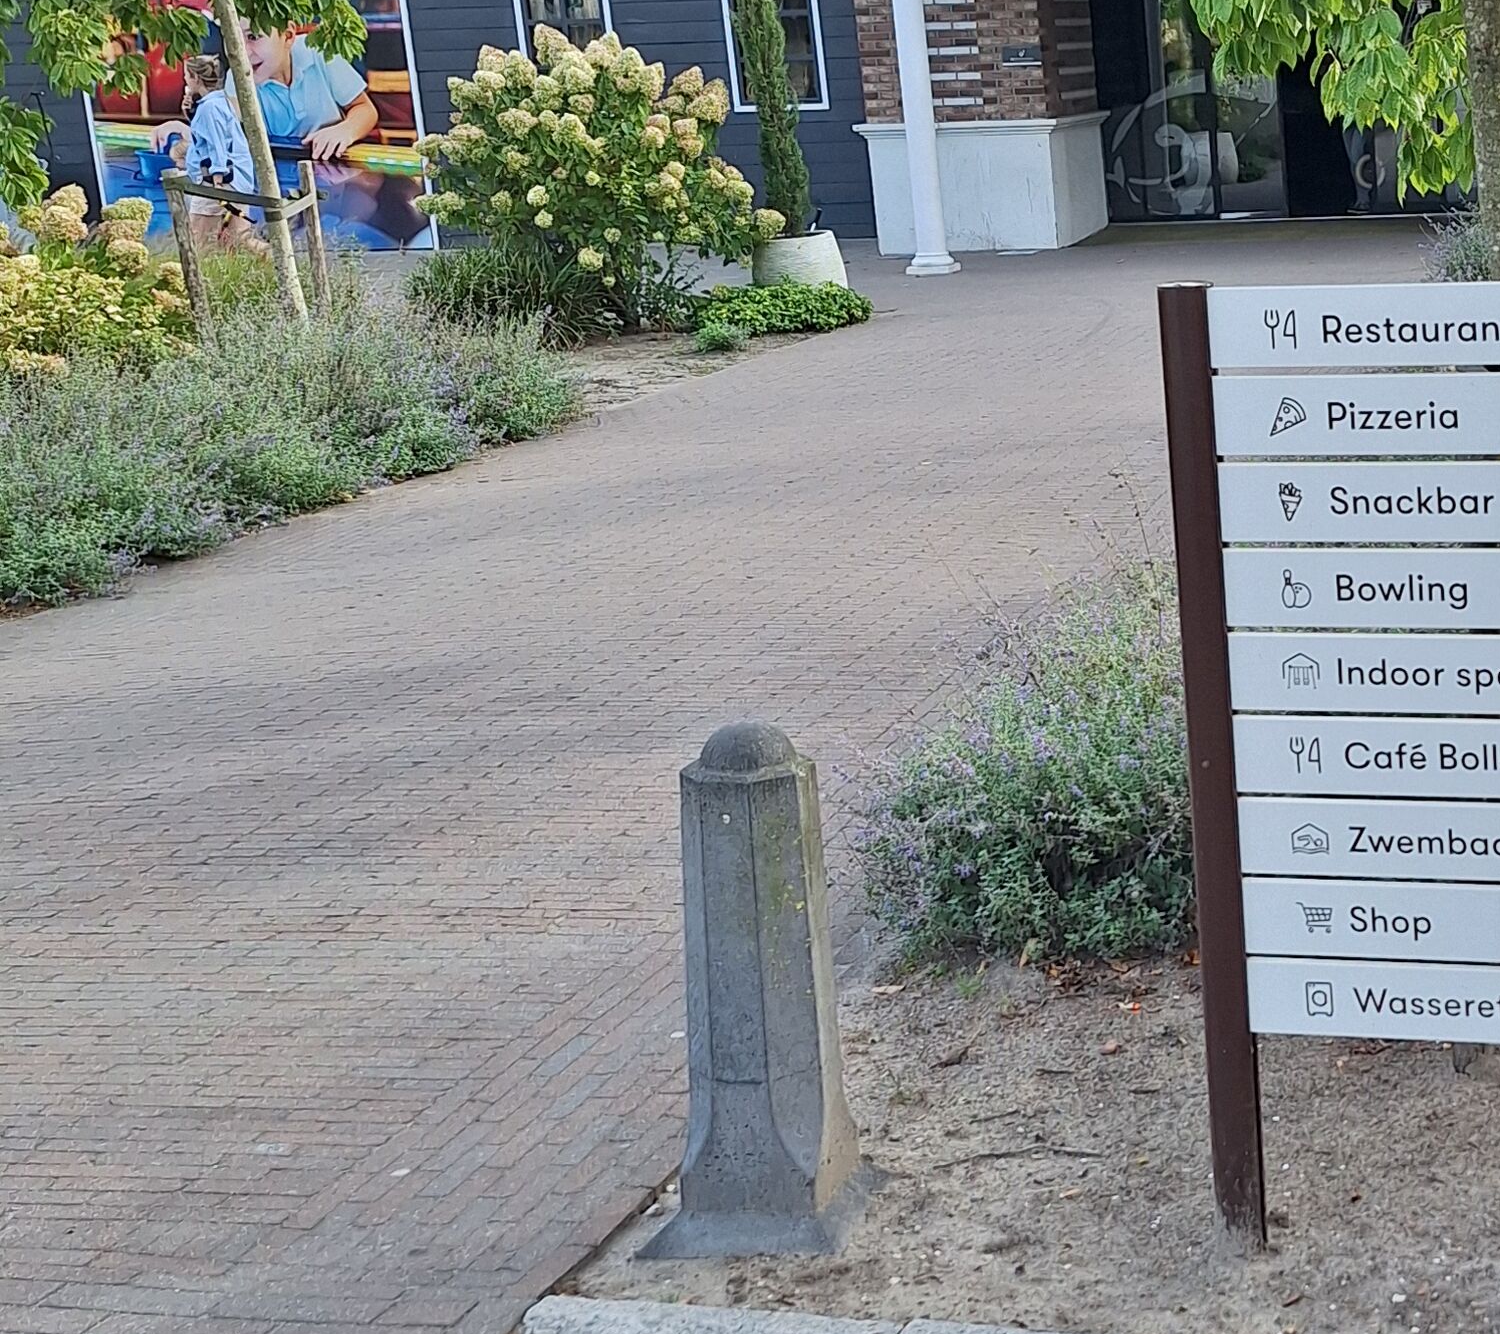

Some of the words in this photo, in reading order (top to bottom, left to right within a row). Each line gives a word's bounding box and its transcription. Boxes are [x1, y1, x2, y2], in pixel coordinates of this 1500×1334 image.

[1327, 400, 1459, 430] Pizzeria
[1330, 486, 1495, 515] Snackbar
[1335, 573, 1468, 610] Bowling
[1337, 657, 1445, 687] Indoor
[1344, 741, 1427, 770] Café
[1350, 905, 1432, 942] Shop
